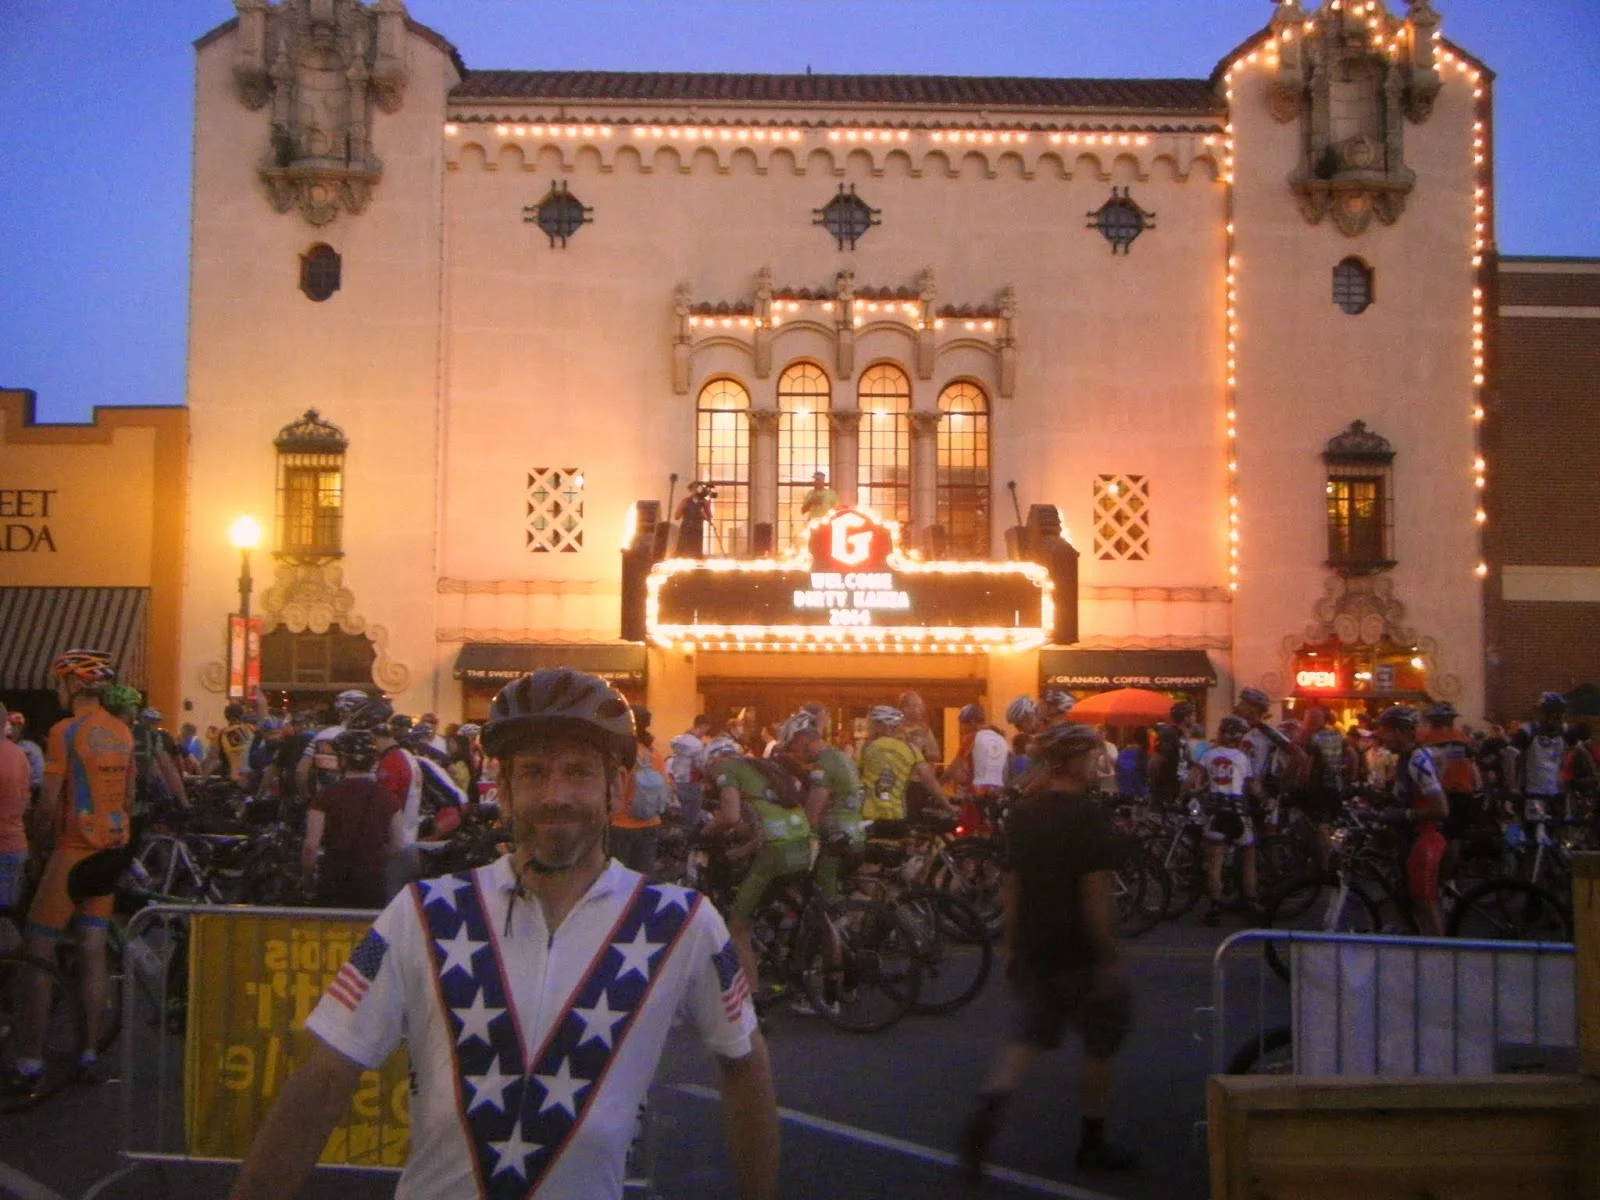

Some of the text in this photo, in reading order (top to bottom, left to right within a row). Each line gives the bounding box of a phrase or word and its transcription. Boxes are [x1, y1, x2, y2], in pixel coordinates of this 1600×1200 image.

[0, 524, 57, 552] DA
[831, 512, 873, 565] G
[810, 572, 893, 590] WELCOME
[1056, 675, 1206, 685] GRANADA COFFEE COMPANY
[1296, 670, 1336, 687] OPEN
